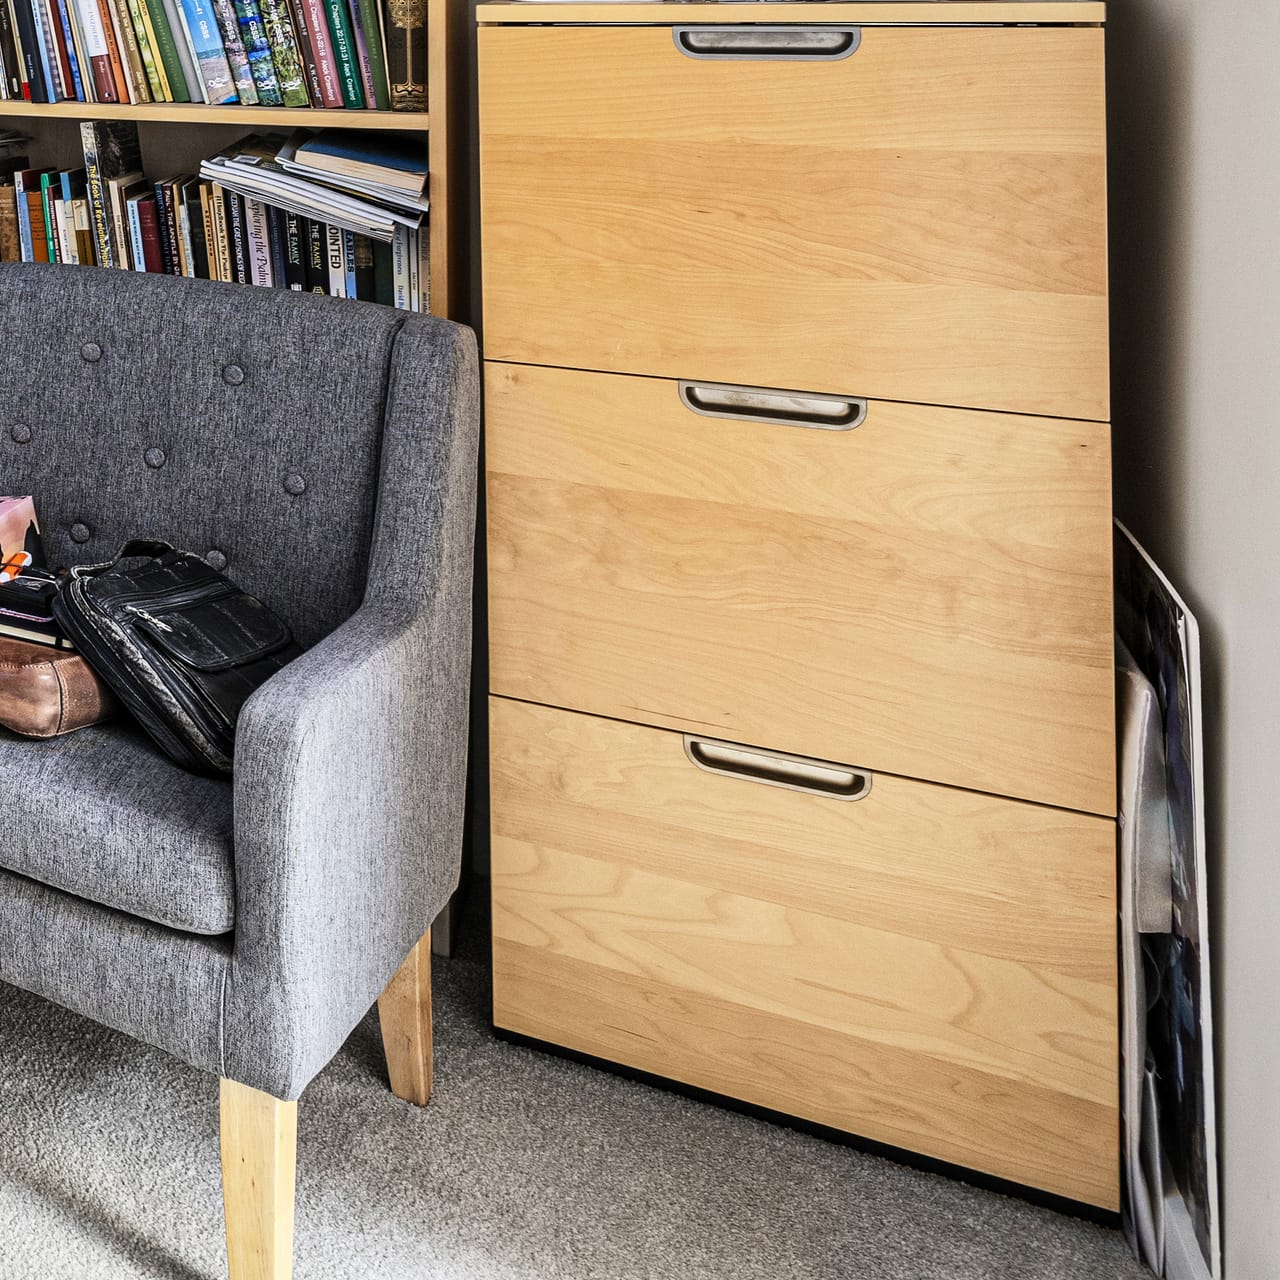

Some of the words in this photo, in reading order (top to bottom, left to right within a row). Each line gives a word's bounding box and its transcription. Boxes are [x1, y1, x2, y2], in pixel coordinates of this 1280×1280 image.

[91, 179, 99, 198] Book
[94, 199, 100, 208] of
[288, 220, 296, 234] THE
[310, 224, 319, 239] THE
[253, 240, 265, 253] the
[289, 236, 300, 264] FAMILY
[311, 241, 322, 269] FAMILY
